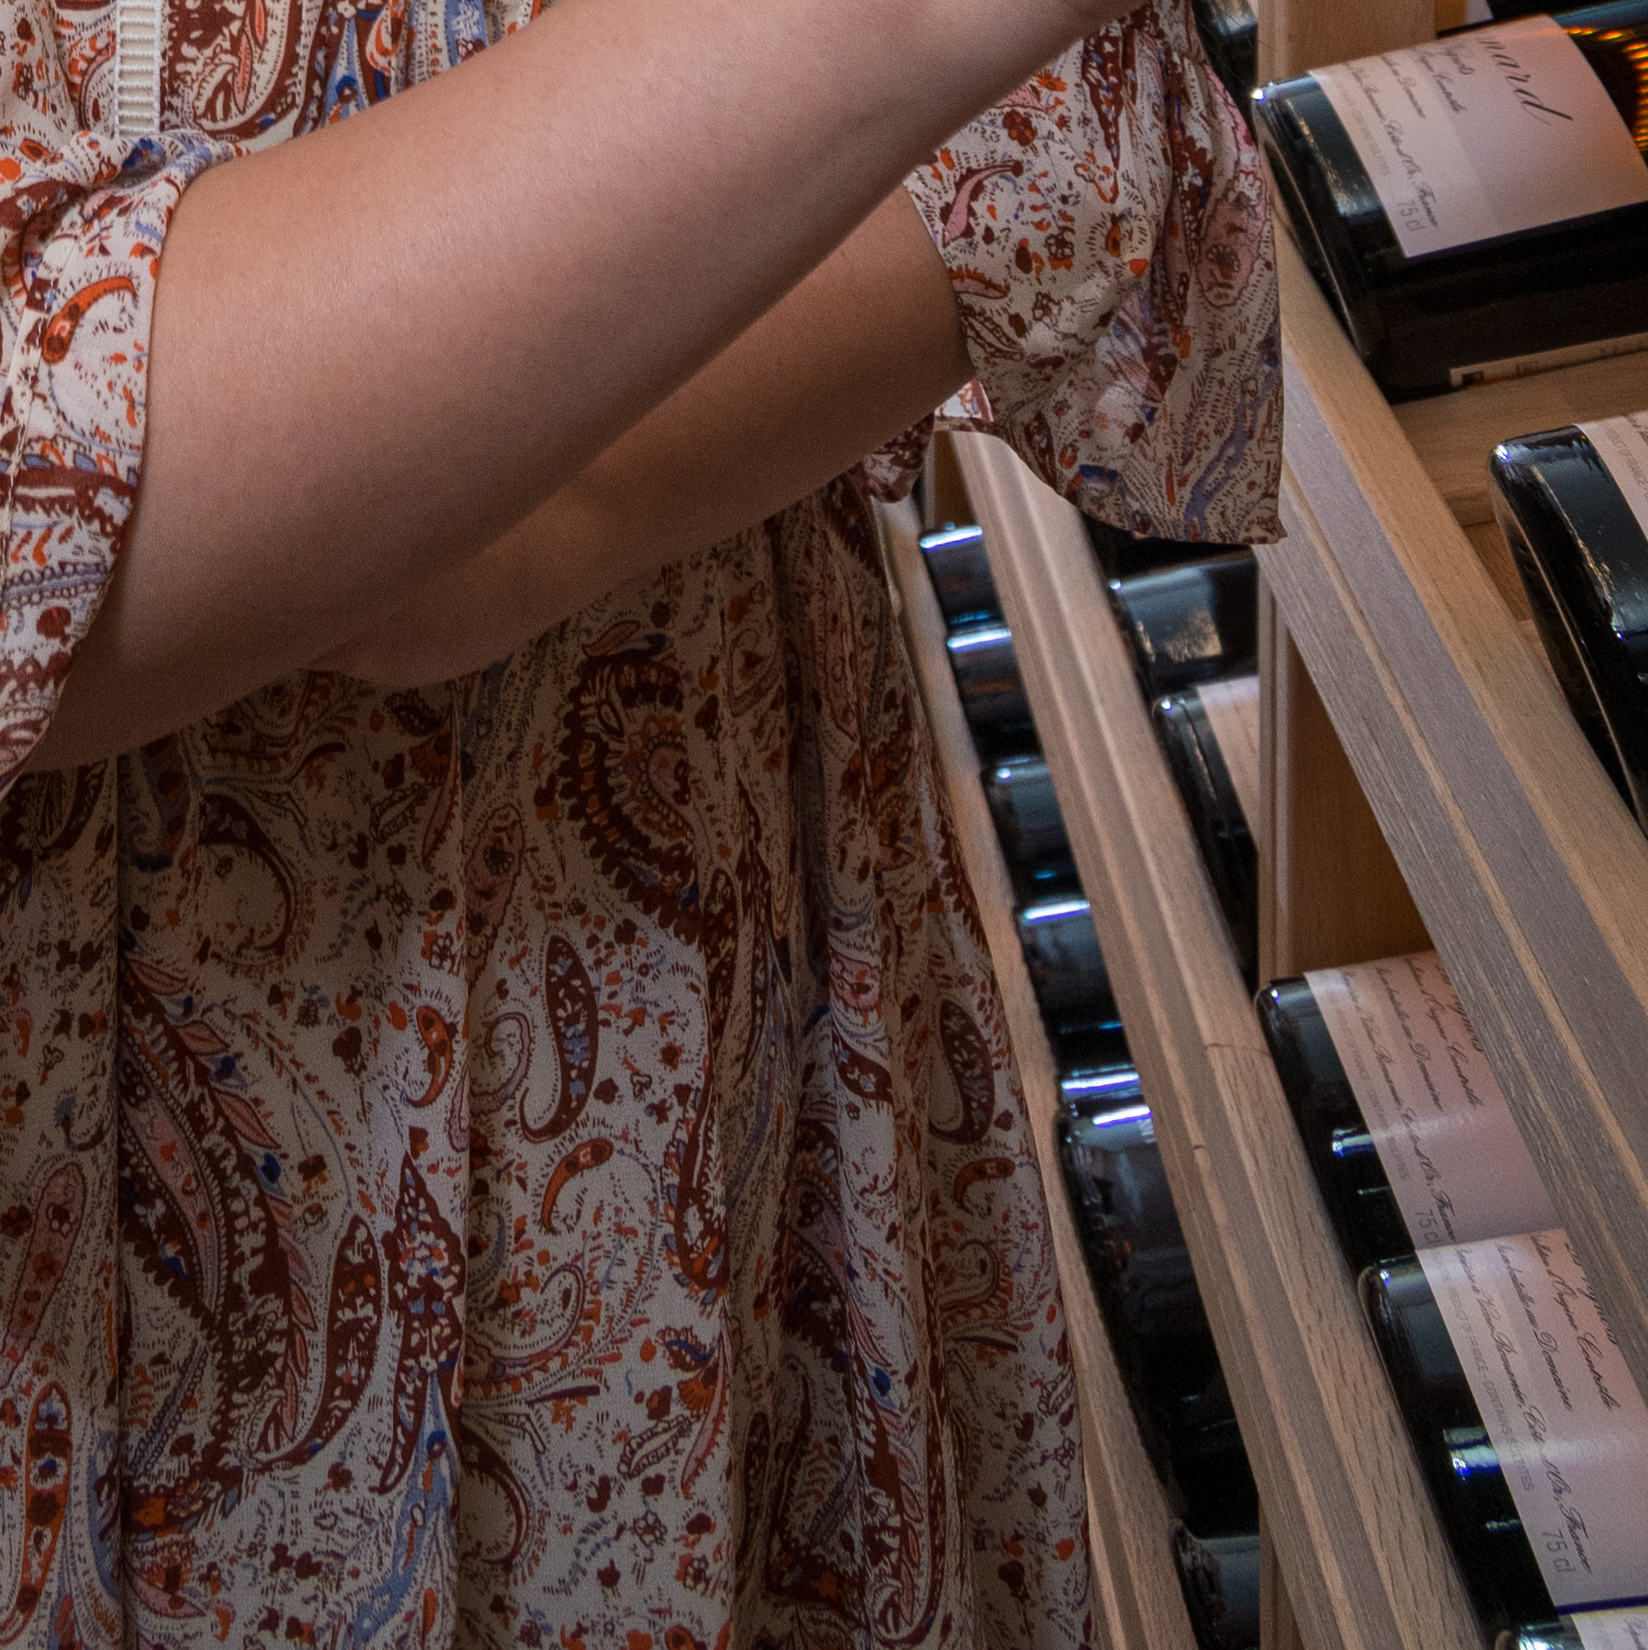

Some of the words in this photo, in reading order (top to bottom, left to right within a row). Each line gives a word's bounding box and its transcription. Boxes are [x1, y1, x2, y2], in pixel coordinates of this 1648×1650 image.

[1397, 199, 1420, 218] 75
[1408, 1042, 1444, 1113] Domaine
[1415, 1208, 1439, 1229] 75
[1431, 1183, 1457, 1243] France
[1532, 1329, 1575, 1414] Domaine
[1577, 1331, 1622, 1413] Contrôlée
[1542, 1528, 1569, 1552] 75
[1552, 1557, 1576, 1575] cl
[1558, 1503, 1592, 1575] France
